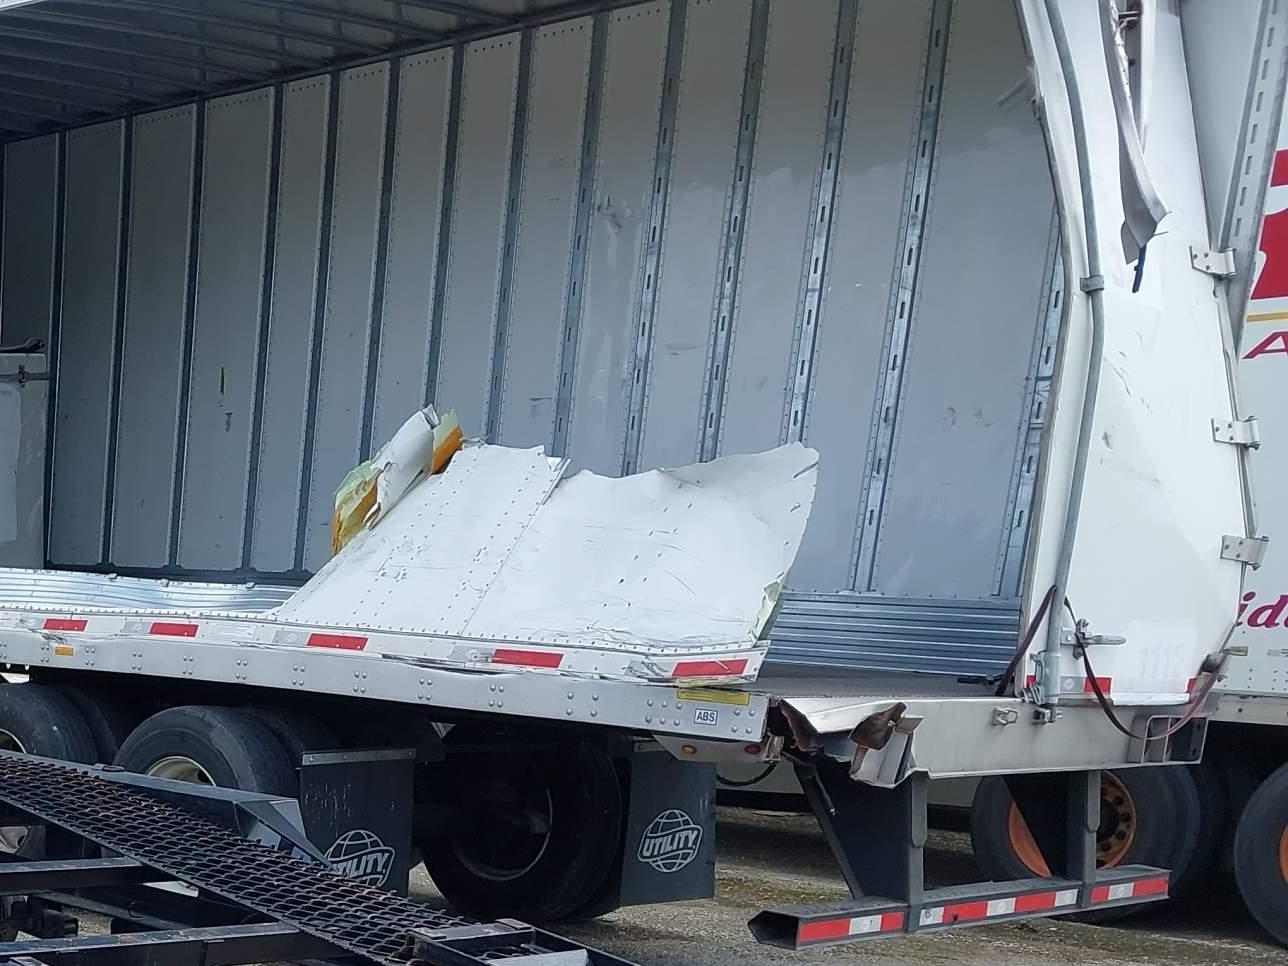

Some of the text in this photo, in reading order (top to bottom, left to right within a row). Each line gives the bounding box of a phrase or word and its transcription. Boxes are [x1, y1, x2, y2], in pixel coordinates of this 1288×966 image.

[696, 710, 716, 723] ABS
[642, 830, 698, 857] UTILITY
[329, 852, 390, 879] TILITY
